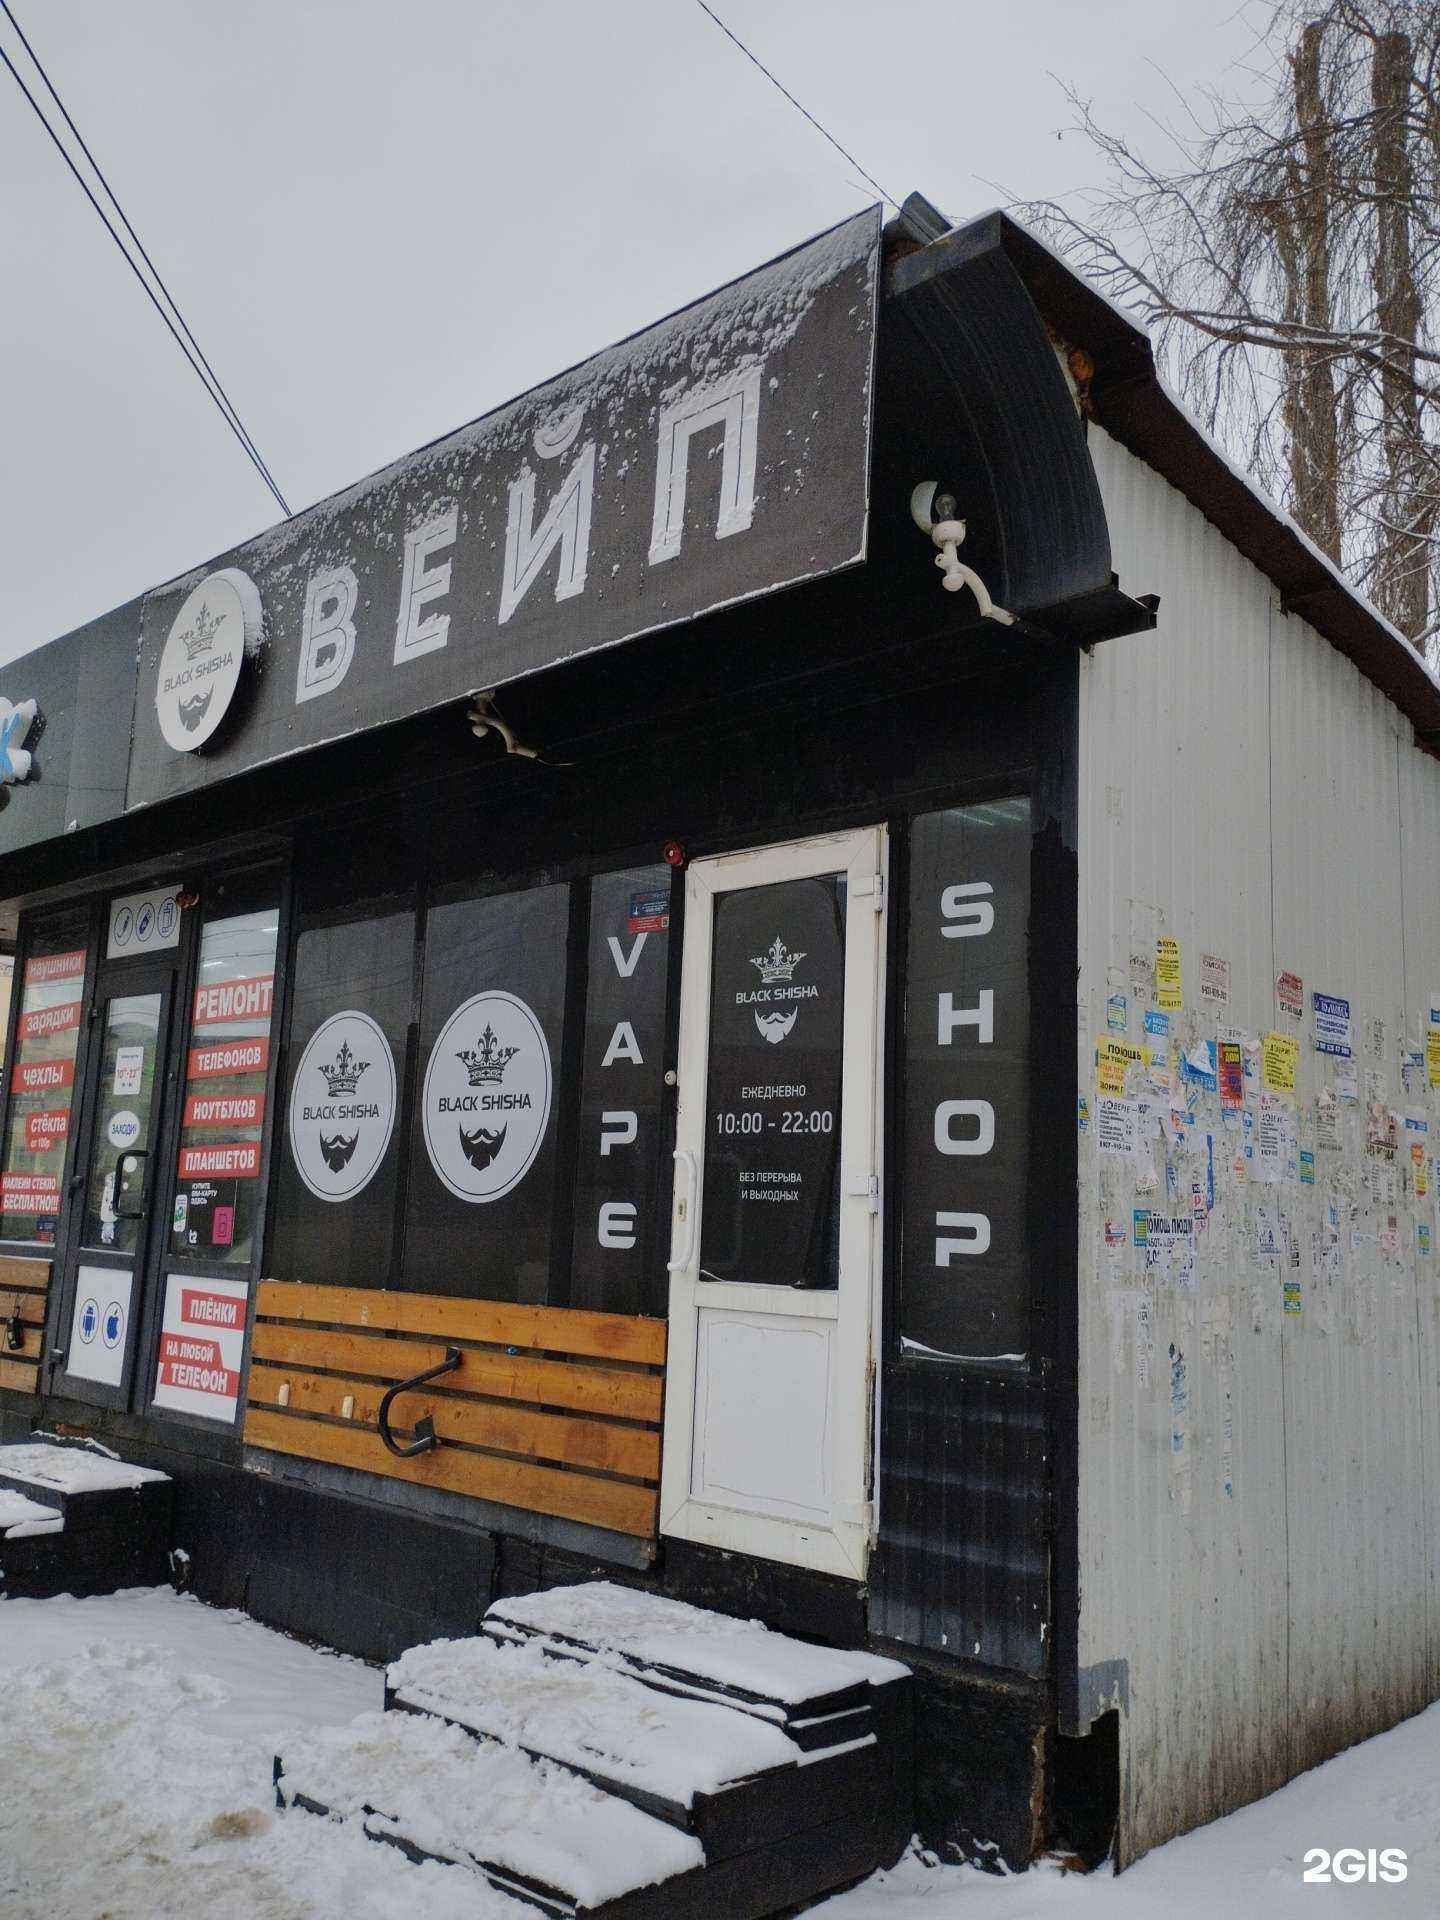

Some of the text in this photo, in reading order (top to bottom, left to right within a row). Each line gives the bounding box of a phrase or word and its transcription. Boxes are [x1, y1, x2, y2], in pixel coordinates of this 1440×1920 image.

[295, 360, 766, 705] ВЕЙП
[164, 651, 233, 693] BLACK SHISHA
[30, 955, 82, 979] наушники
[195, 981, 273, 1019] РЕМОНТ
[736, 985, 819, 1004] BLACK SHISHA
[26, 1007, 75, 1034] зарядки
[198, 1046, 261, 1071] ТЕЛЕФОНОВ
[23, 1066, 64, 1086] чехлы
[934, 881, 995, 1267] SHOP
[598, 932, 648, 1250] VAPE
[741, 1084, 807, 1100] ЕЖЕДНЕВНО
[193, 1100, 256, 1120] НОУТБУКОВ
[303, 1103, 380, 1120] BLACK SHISHA
[439, 1093, 532, 1113] BLACK SHISHA
[31, 1115, 66, 1133] стёкла
[716, 1112, 763, 1134] 10:00
[781, 1110, 833, 1133] 22:00
[185, 1150, 255, 1171] ПЛАНШЕТОВ
[739, 1172, 802, 1183] БЕЗ ПЕРЕРЫВА
[741, 1190, 799, 1202] И ВЫХОДНЫХ
[190, 1297, 237, 1325] ПЛЁНКИ
[166, 1340, 214, 1363] НА ЛЮБОЙ
[171, 1363, 229, 1394] ТЕЛЕФОН
